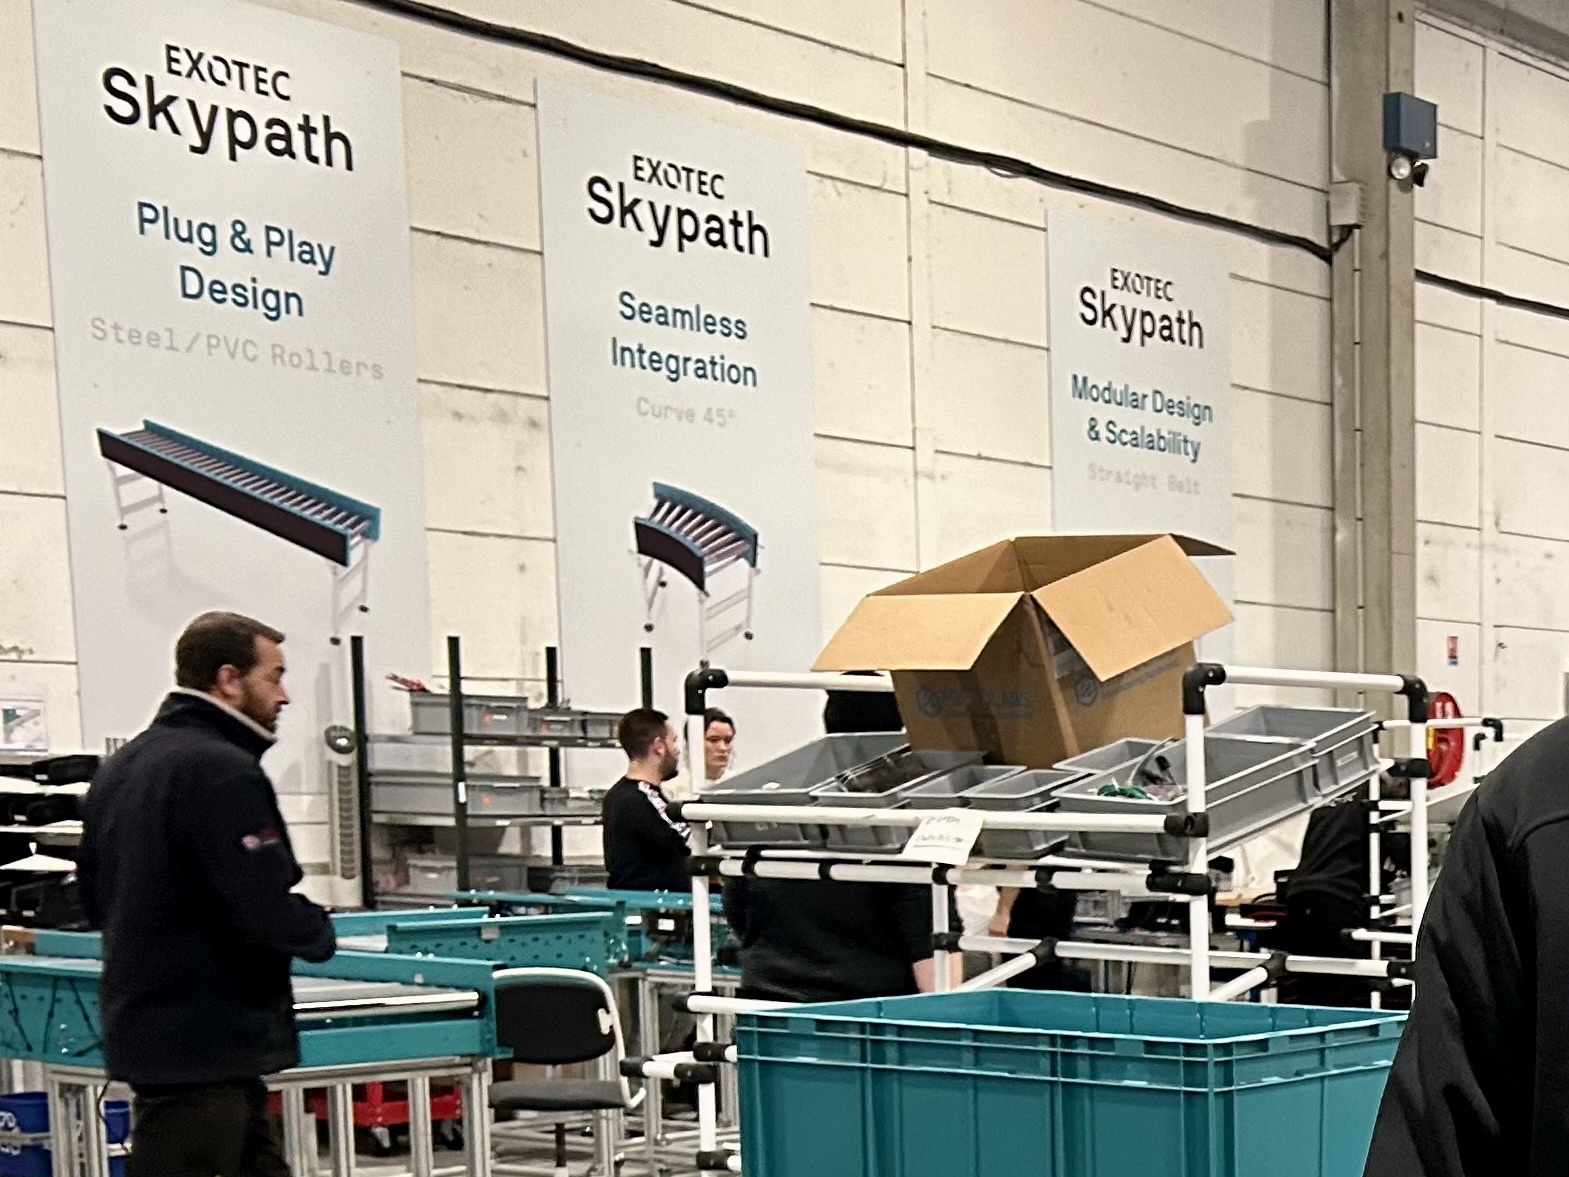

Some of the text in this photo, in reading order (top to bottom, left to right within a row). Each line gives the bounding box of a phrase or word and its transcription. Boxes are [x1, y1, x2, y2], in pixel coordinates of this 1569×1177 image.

[165, 43, 291, 101] EXOTEC
[102, 66, 354, 172] Skypath
[632, 154, 725, 200] EXOTEC
[137, 200, 335, 276] Plug & Play
[587, 175, 770, 258] Skypath
[179, 264, 304, 321] Design
[1110, 267, 1174, 302] EXOTEC
[618, 290, 748, 340] Seamless
[1079, 285, 1204, 349] Skypath
[90, 316, 385, 380] Steel/PVC Rollers
[611, 336, 758, 388] Integration
[636, 396, 696, 424] Curve
[1071, 373, 1213, 426] Modular Design
[1087, 416, 1201, 464] & Scalability
